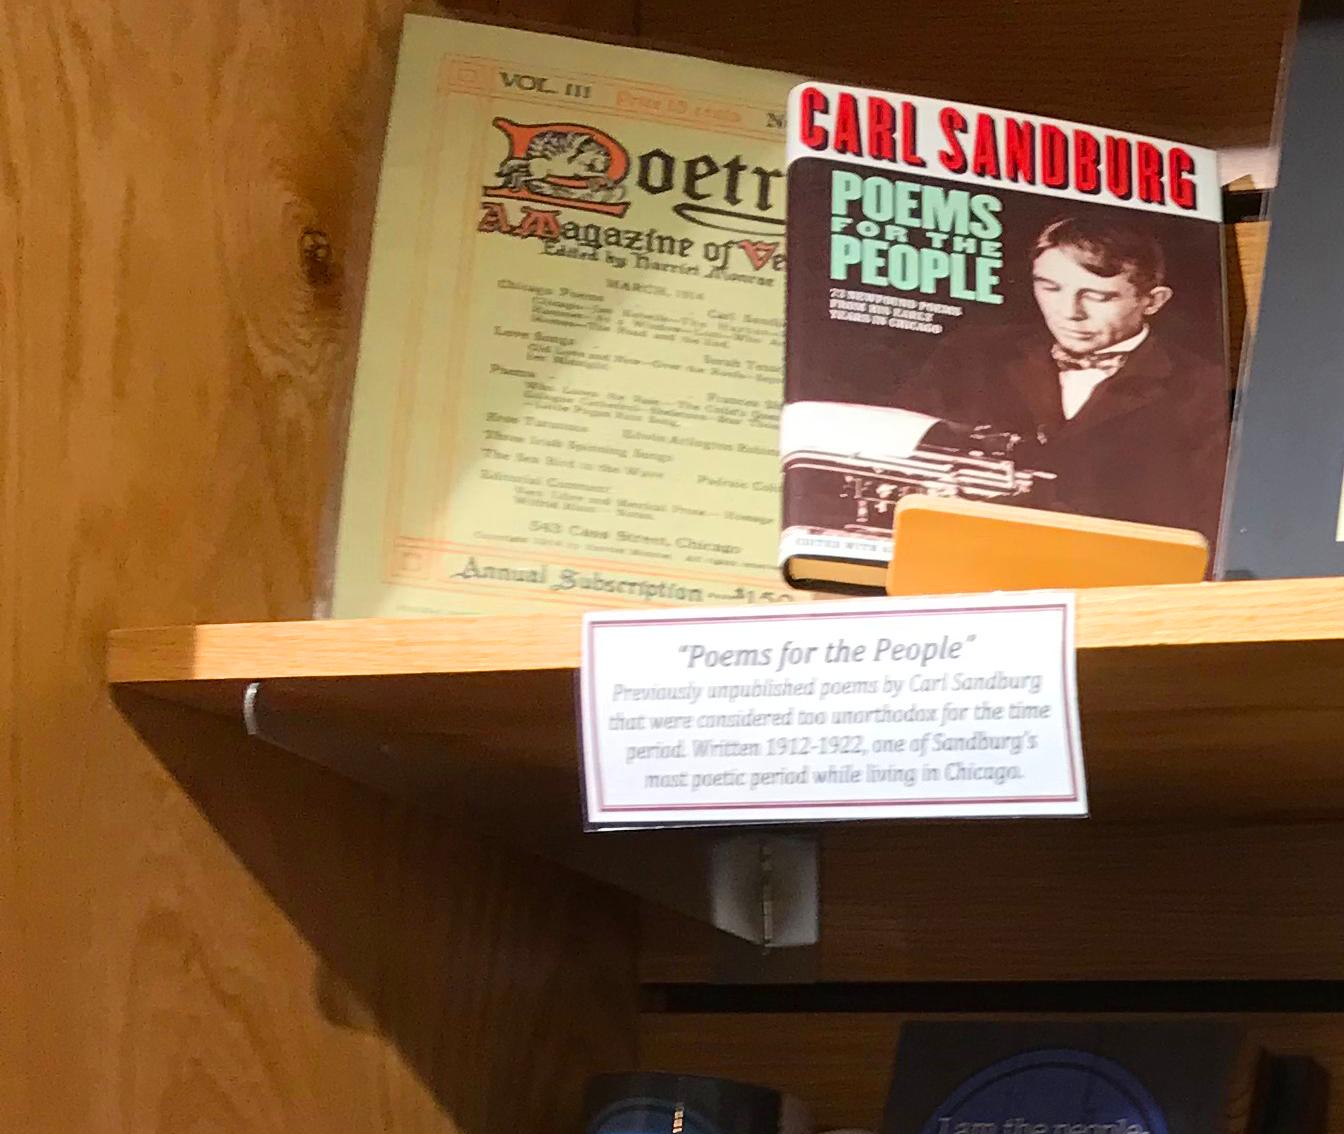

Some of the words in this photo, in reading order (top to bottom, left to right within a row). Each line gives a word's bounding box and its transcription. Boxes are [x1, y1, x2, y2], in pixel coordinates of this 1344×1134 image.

[482, 116, 787, 218] Poetr
[800, 87, 926, 167] CARL
[938, 107, 1198, 210] SANDBURG
[832, 170, 1003, 239] POEMS
[832, 216, 907, 242] FOR
[926, 232, 1003, 257] THE
[830, 235, 1003, 304] PEOPLE
[778, 641, 817, 671] for
[824, 636, 865, 664] the
[613, 681, 702, 703] Previously
[708, 678, 815, 699] unpublished
[820, 679, 877, 700] poems
[883, 676, 903, 697] by
[910, 674, 946, 693] Carl
[952, 672, 1041, 695] Sandburg
[609, 712, 645, 732] that
[650, 714, 692, 730] were
[697, 707, 792, 729] considered
[798, 709, 827, 726] too
[832, 704, 936, 724] unorthodox
[941, 702, 969, 726] for
[974, 702, 1002, 721] the
[1009, 702, 1051, 720] time
[692, 737, 761, 757] Written
[766, 734, 869, 757] 1912-1922,
[873, 735, 905, 754] one
[910, 732, 931, 756] of
[645, 769, 686, 788] most
[692, 768, 745, 790] poetic
[751, 766, 806, 789] period
[813, 766, 861, 785] while
[866, 765, 917, 787] living
[921, 764, 939, 782] in
[945, 762, 1024, 785] Chicago.
